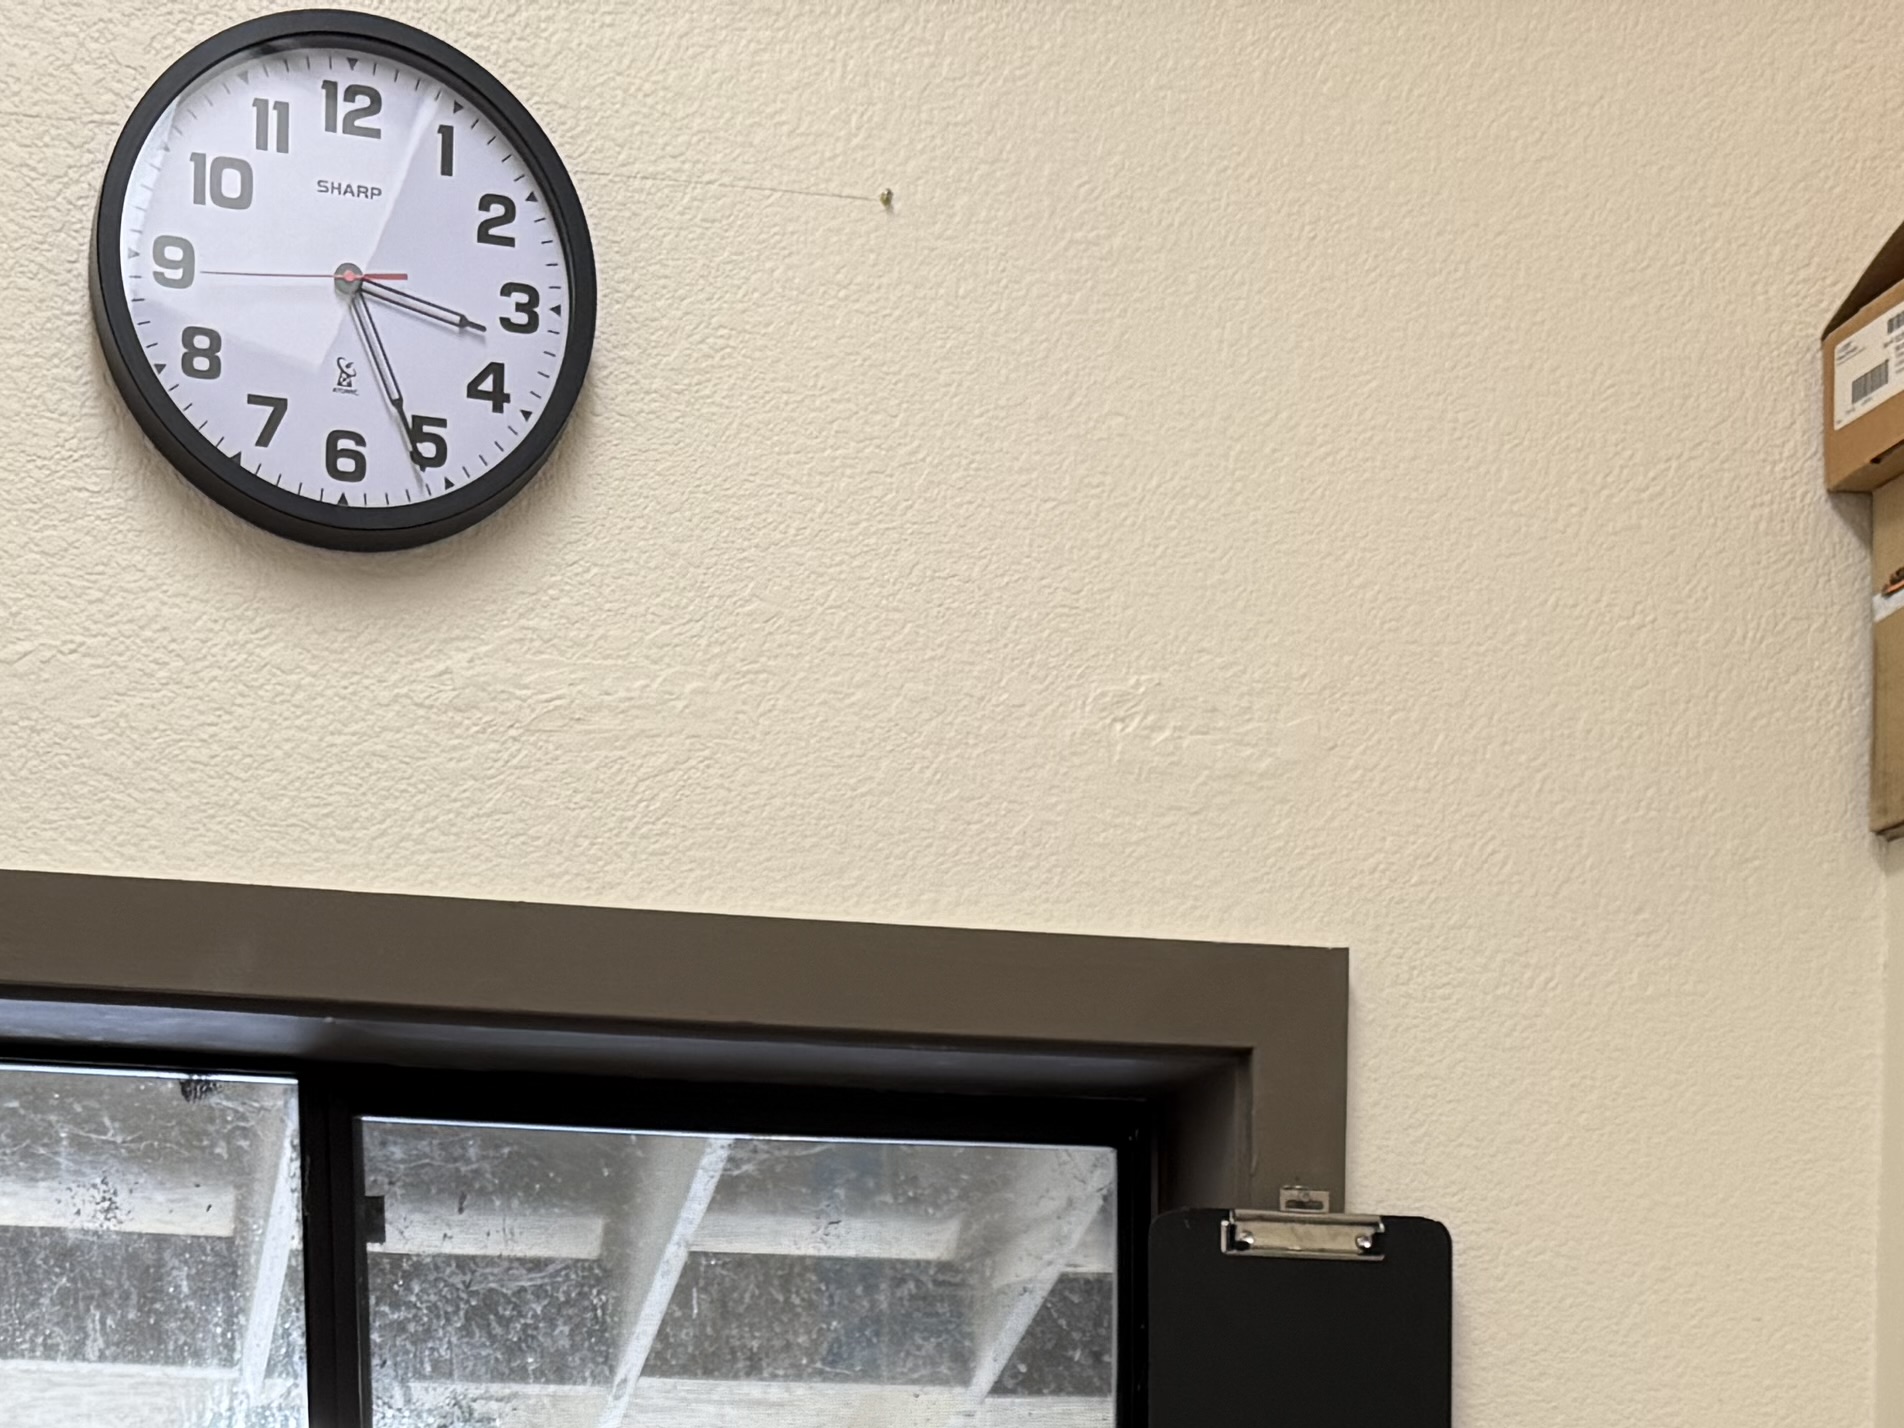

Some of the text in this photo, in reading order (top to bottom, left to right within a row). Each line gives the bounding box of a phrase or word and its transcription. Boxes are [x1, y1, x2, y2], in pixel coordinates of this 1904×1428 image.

[252, 97, 290, 154] 11
[321, 80, 383, 140] 12
[437, 124, 454, 177] 1
[190, 152, 253, 210] 10
[316, 179, 383, 200] SHARP
[476, 194, 516, 248] 2
[152, 236, 196, 289] 9
[499, 282, 540, 334] 3
[181, 326, 222, 379] 8
[466, 362, 511, 414] 4
[247, 394, 288, 448] 7
[410, 417, 448, 470] 5
[326, 430, 367, 482] 6
